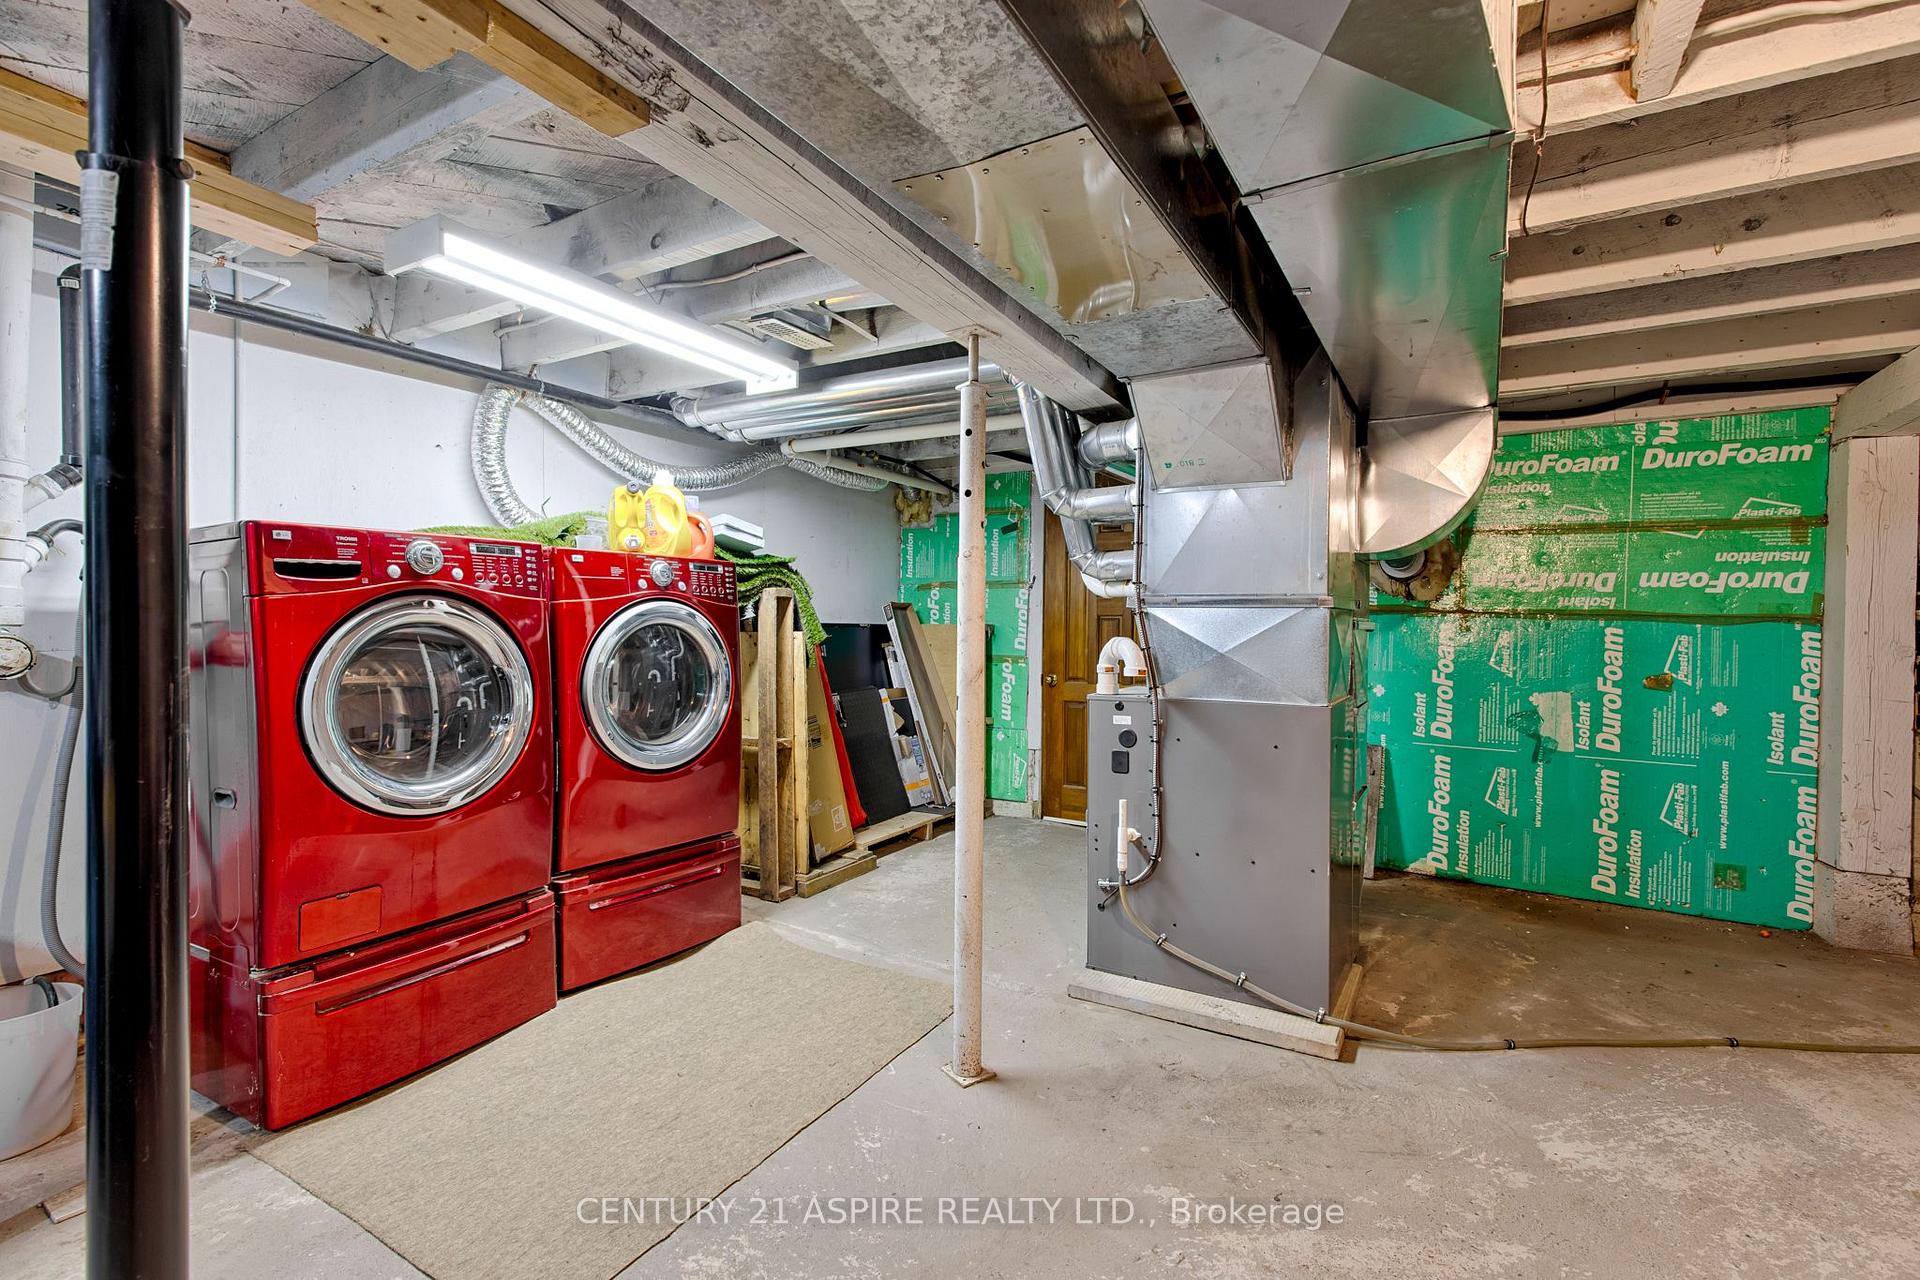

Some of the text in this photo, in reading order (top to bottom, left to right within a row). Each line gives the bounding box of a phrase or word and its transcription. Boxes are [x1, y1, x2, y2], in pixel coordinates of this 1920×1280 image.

[1491, 454, 1620, 476] uroFoam
[1641, 443, 1813, 469] DuroFoam
[1486, 482, 1551, 494] sulation
[906, 532, 914, 578] Insulation
[991, 529, 999, 577] Insulation
[1715, 551, 1811, 564] Insulation
[1639, 572, 1810, 594] DuroFoam
[1430, 622, 1456, 740] DuroFoam
[1595, 626, 1624, 753] DuroFoam
[1791, 631, 1822, 768] DuroFoam
[1412, 691, 1426, 738] Isolant
[1575, 700, 1591, 750] Isolant
[1767, 711, 1785, 766] Isolant
[1426, 754, 1452, 871] DuroFoam
[1719, 760, 1730, 849] www.plastifab.com
[1455, 809, 1470, 874] Insulation
[1591, 769, 1620, 896] DuroFoam
[1787, 786, 1817, 924] DuroFoam
[1625, 829, 1642, 898] Insulation
